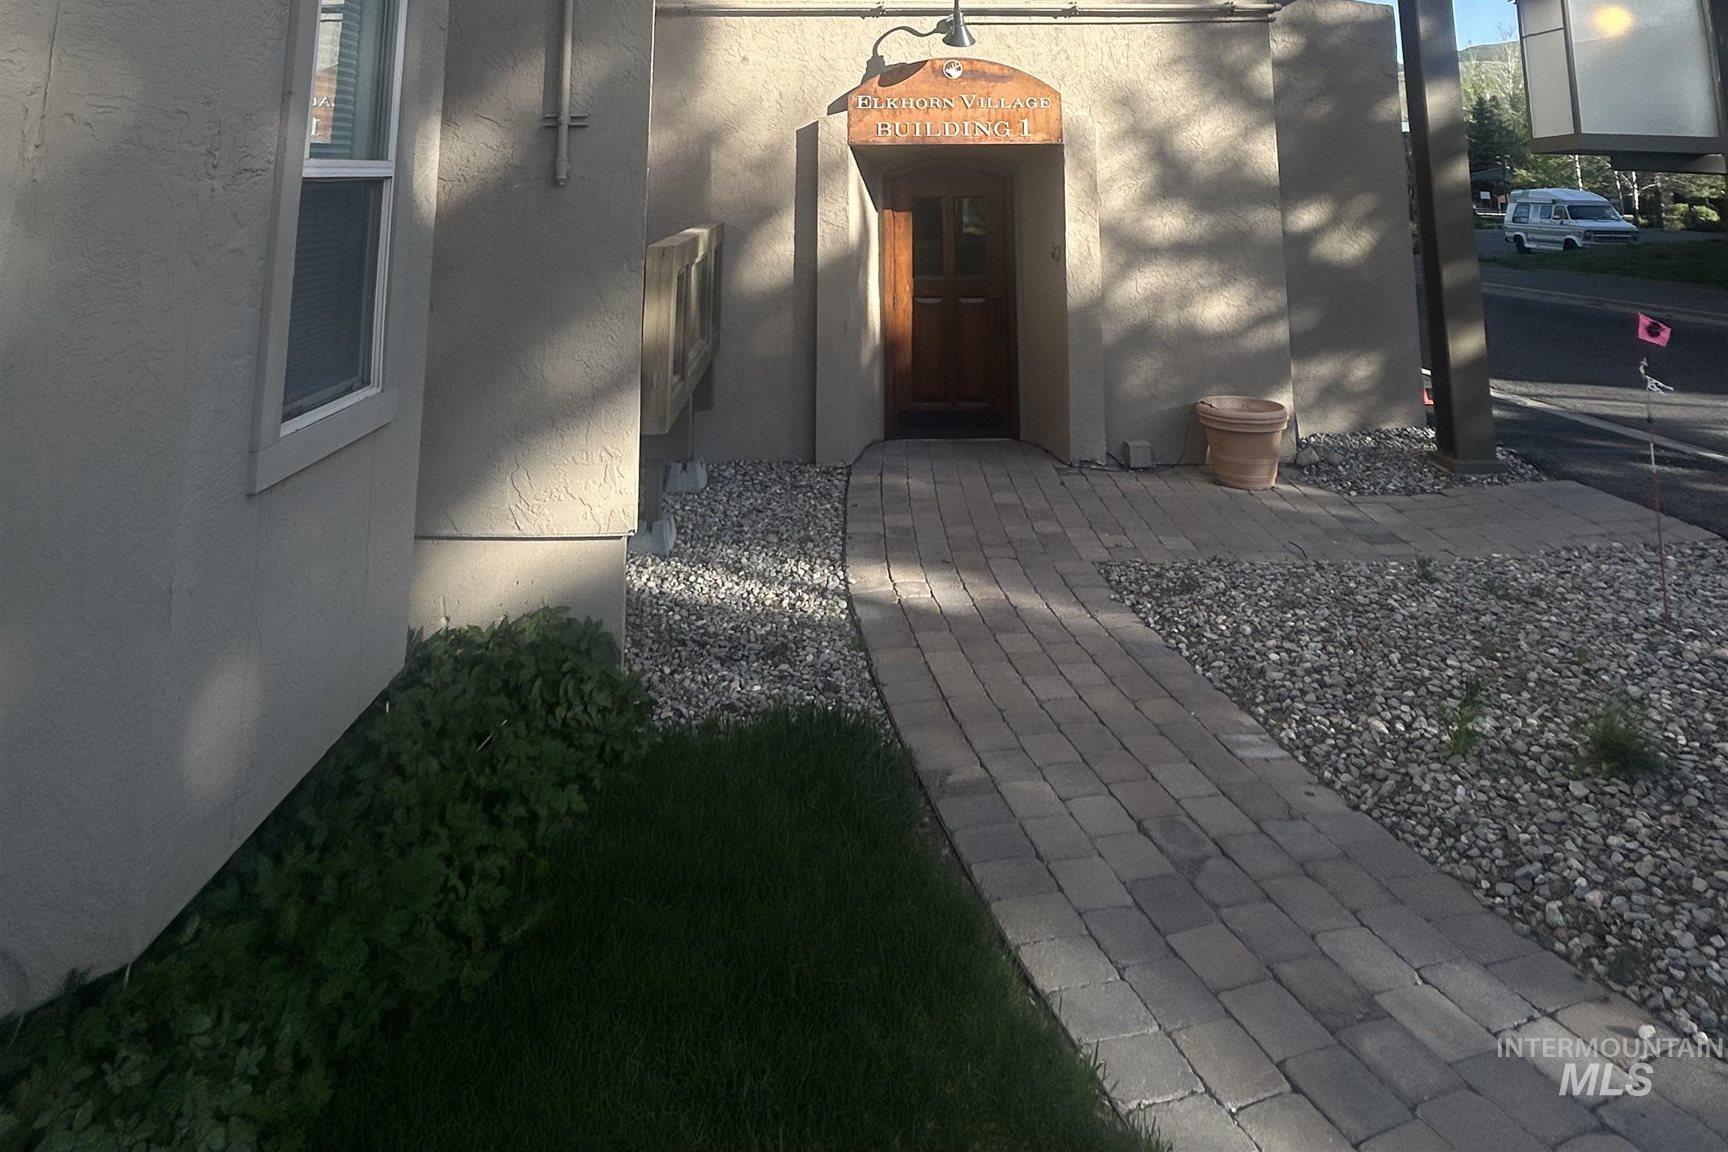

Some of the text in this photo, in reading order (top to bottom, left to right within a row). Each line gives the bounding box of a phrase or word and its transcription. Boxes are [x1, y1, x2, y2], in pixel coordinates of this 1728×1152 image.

[856, 94, 1051, 109] ELKHORN VILLAGE
[875, 118, 1032, 138] BUILDING 1
